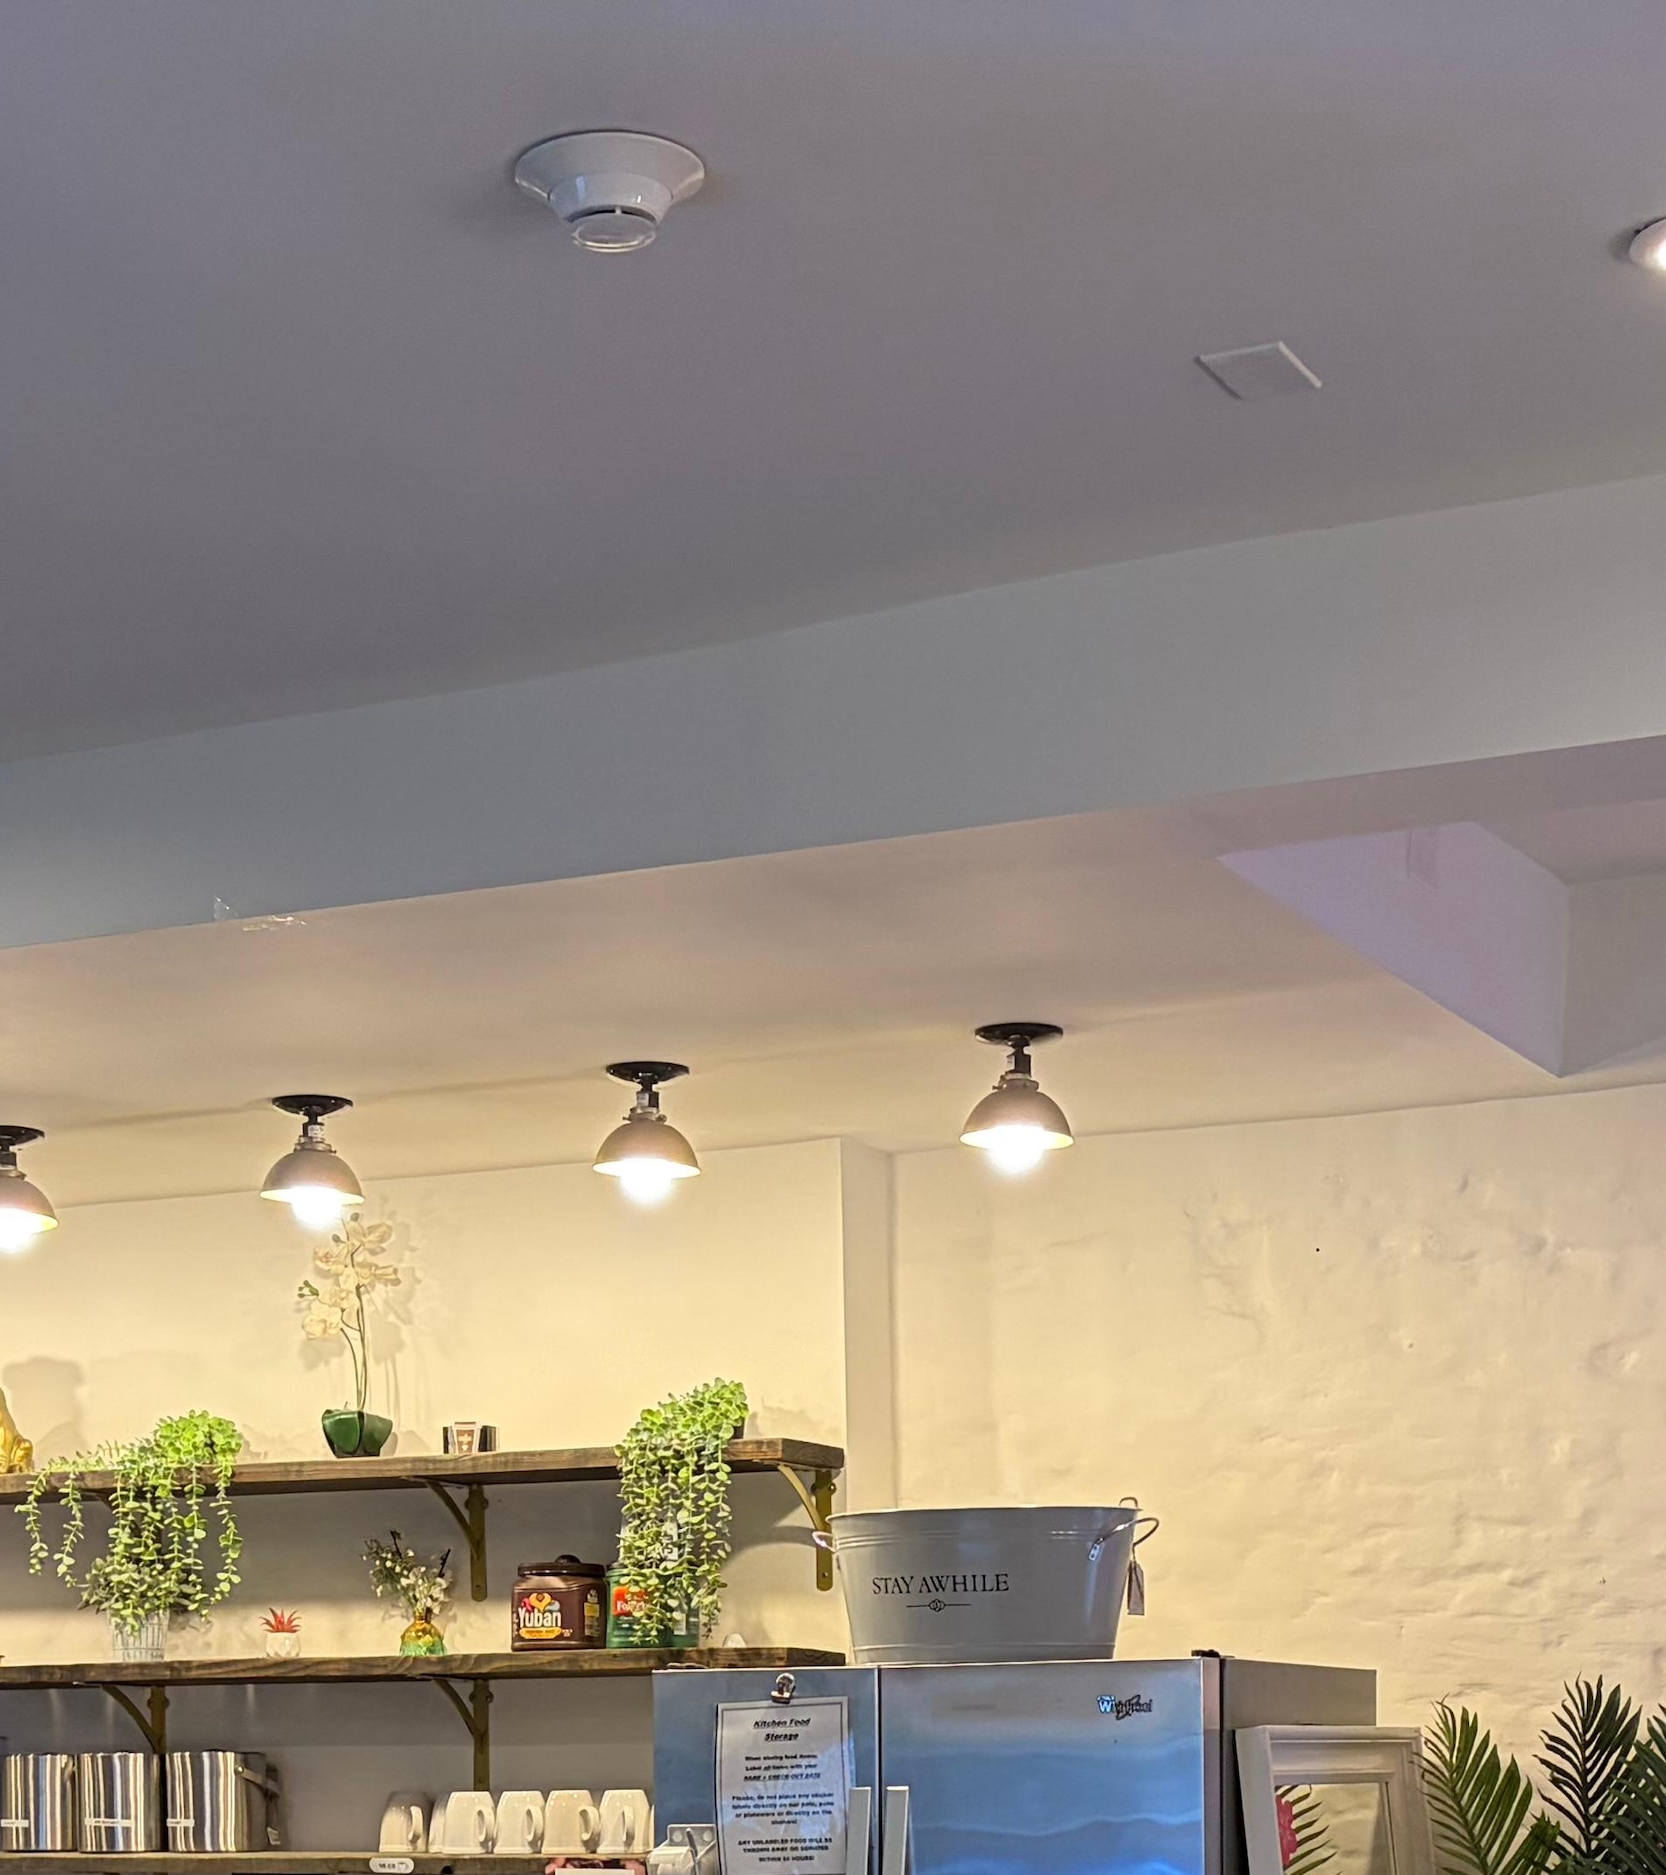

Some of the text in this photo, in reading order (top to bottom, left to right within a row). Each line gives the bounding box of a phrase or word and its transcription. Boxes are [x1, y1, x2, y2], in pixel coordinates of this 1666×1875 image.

[872, 1573, 1009, 1595] STAY AWHILE
[518, 1607, 561, 1628] Yuban
[754, 1718, 811, 1729] Kitchen Food
[764, 1732, 799, 1741] Storage
